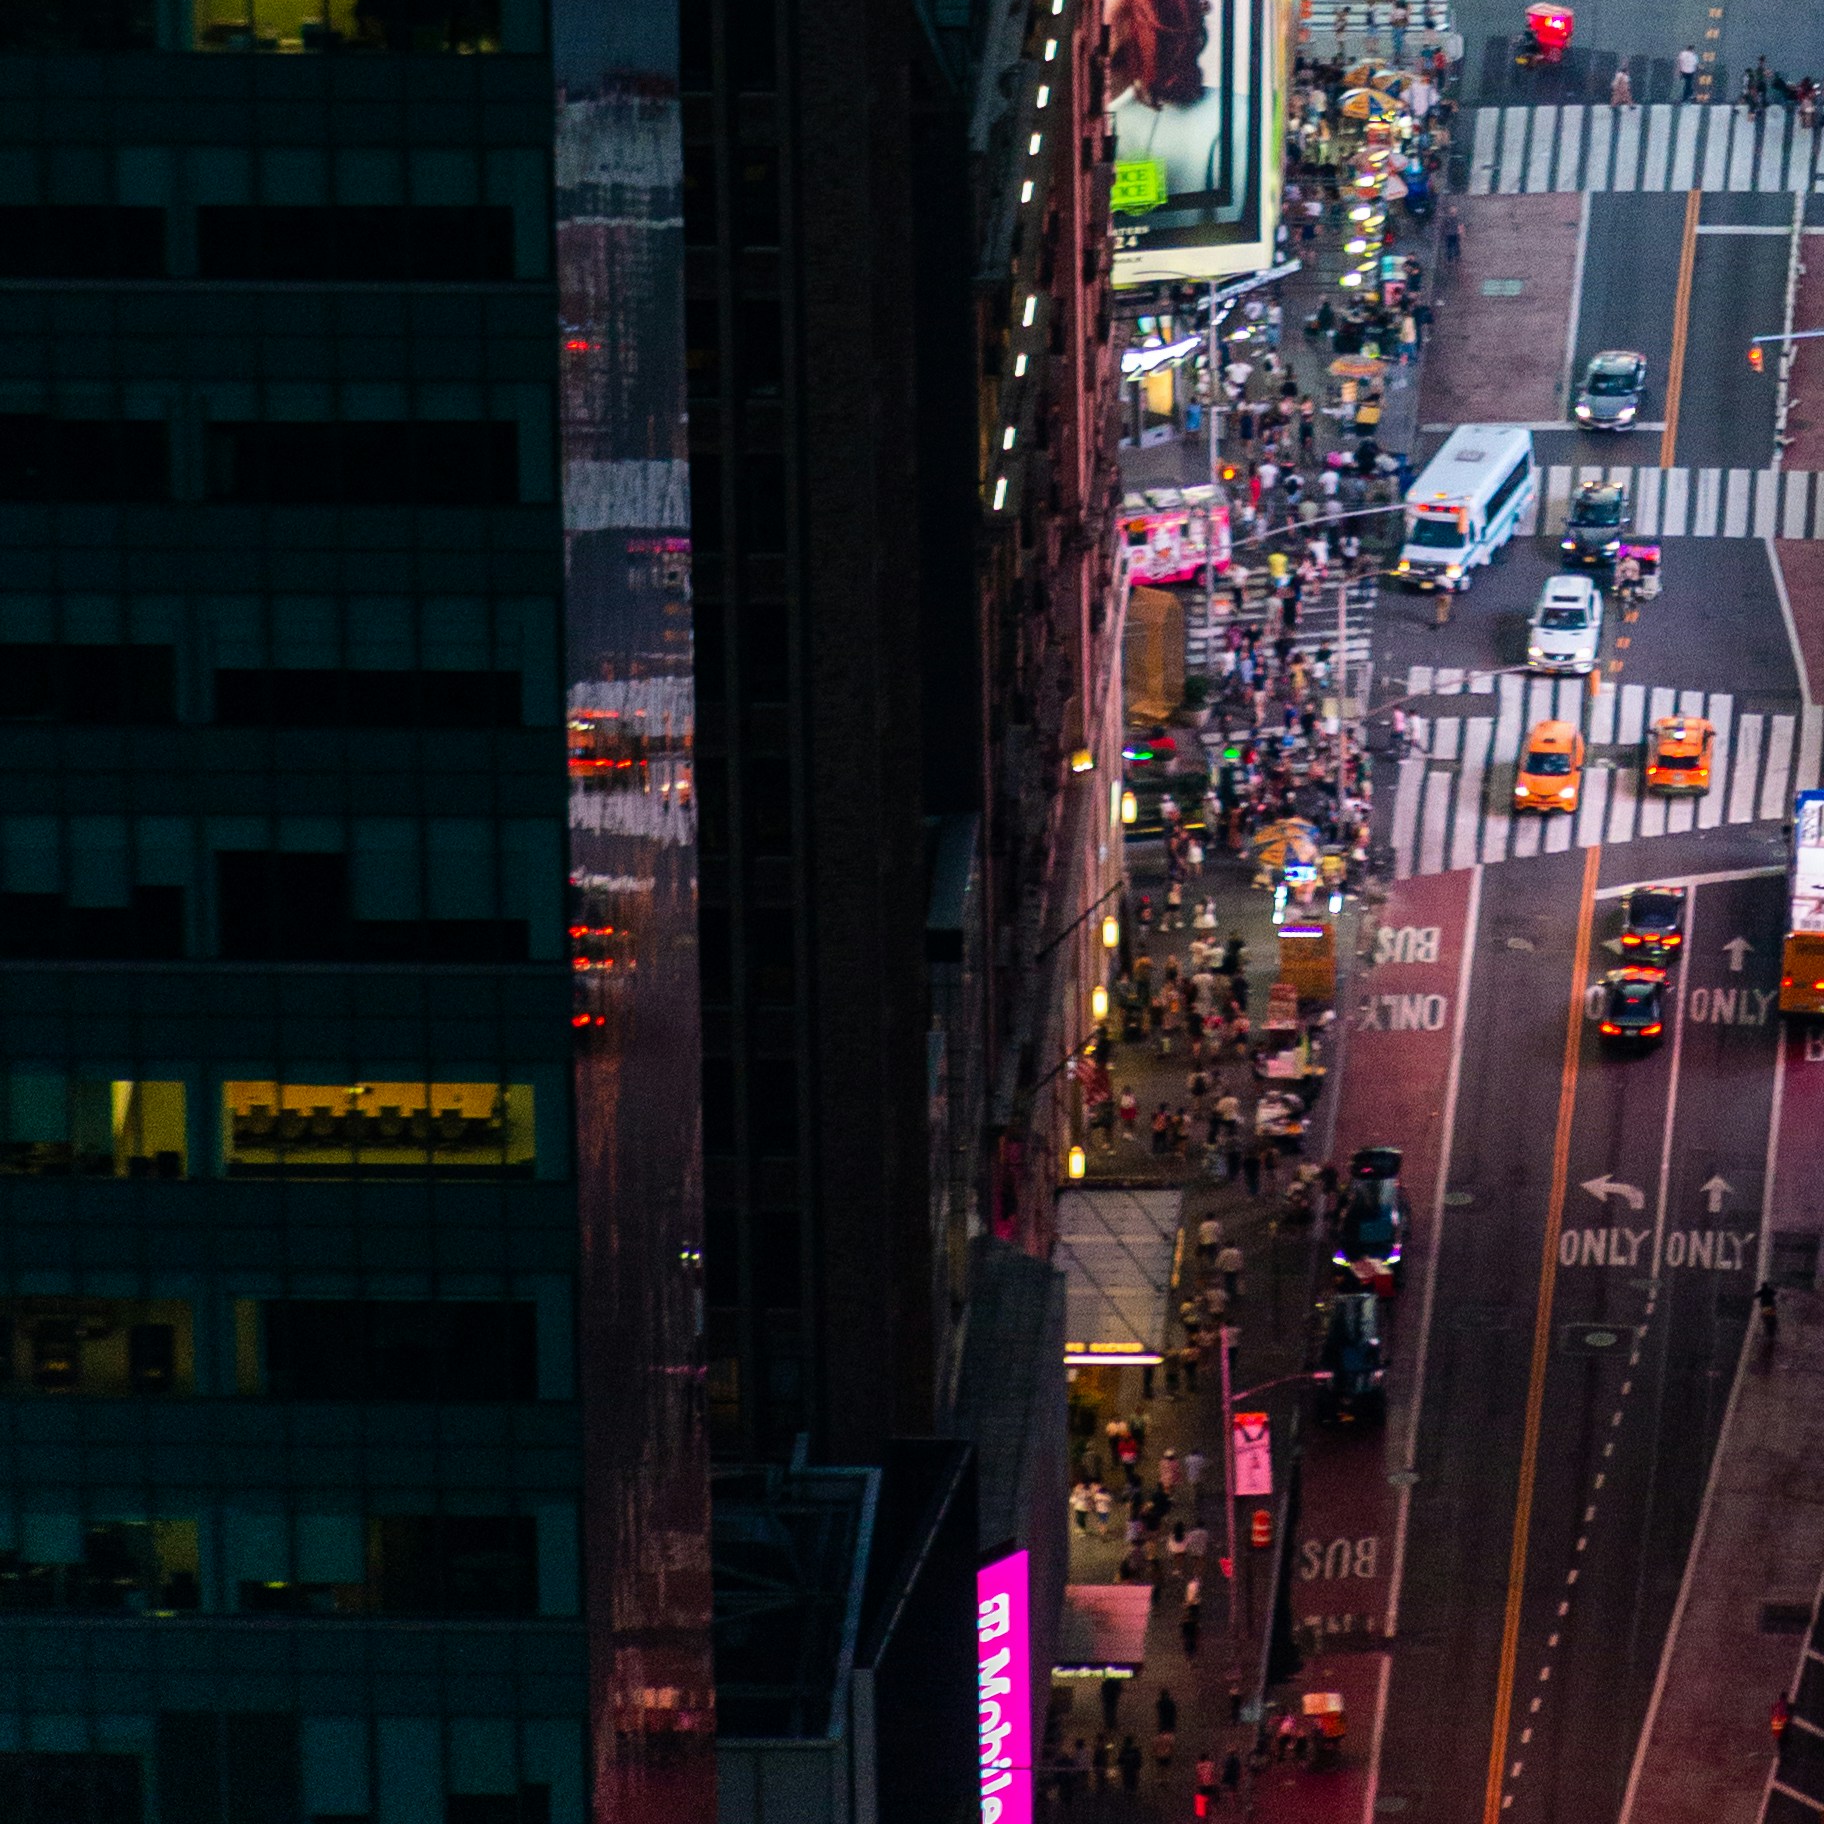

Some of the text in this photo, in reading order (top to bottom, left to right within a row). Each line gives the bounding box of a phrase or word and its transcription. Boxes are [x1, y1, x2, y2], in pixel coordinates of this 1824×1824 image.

[1375, 926, 1441, 964] BUS
[1357, 994, 1448, 1031] ONLY
[1689, 987, 1777, 1025] ONLY
[1559, 1228, 1652, 1266] ONLY
[1666, 1230, 1756, 1270] ONLY
[1300, 1536, 1379, 1581] BUS
[978, 1646, 1013, 1824] Mobile
